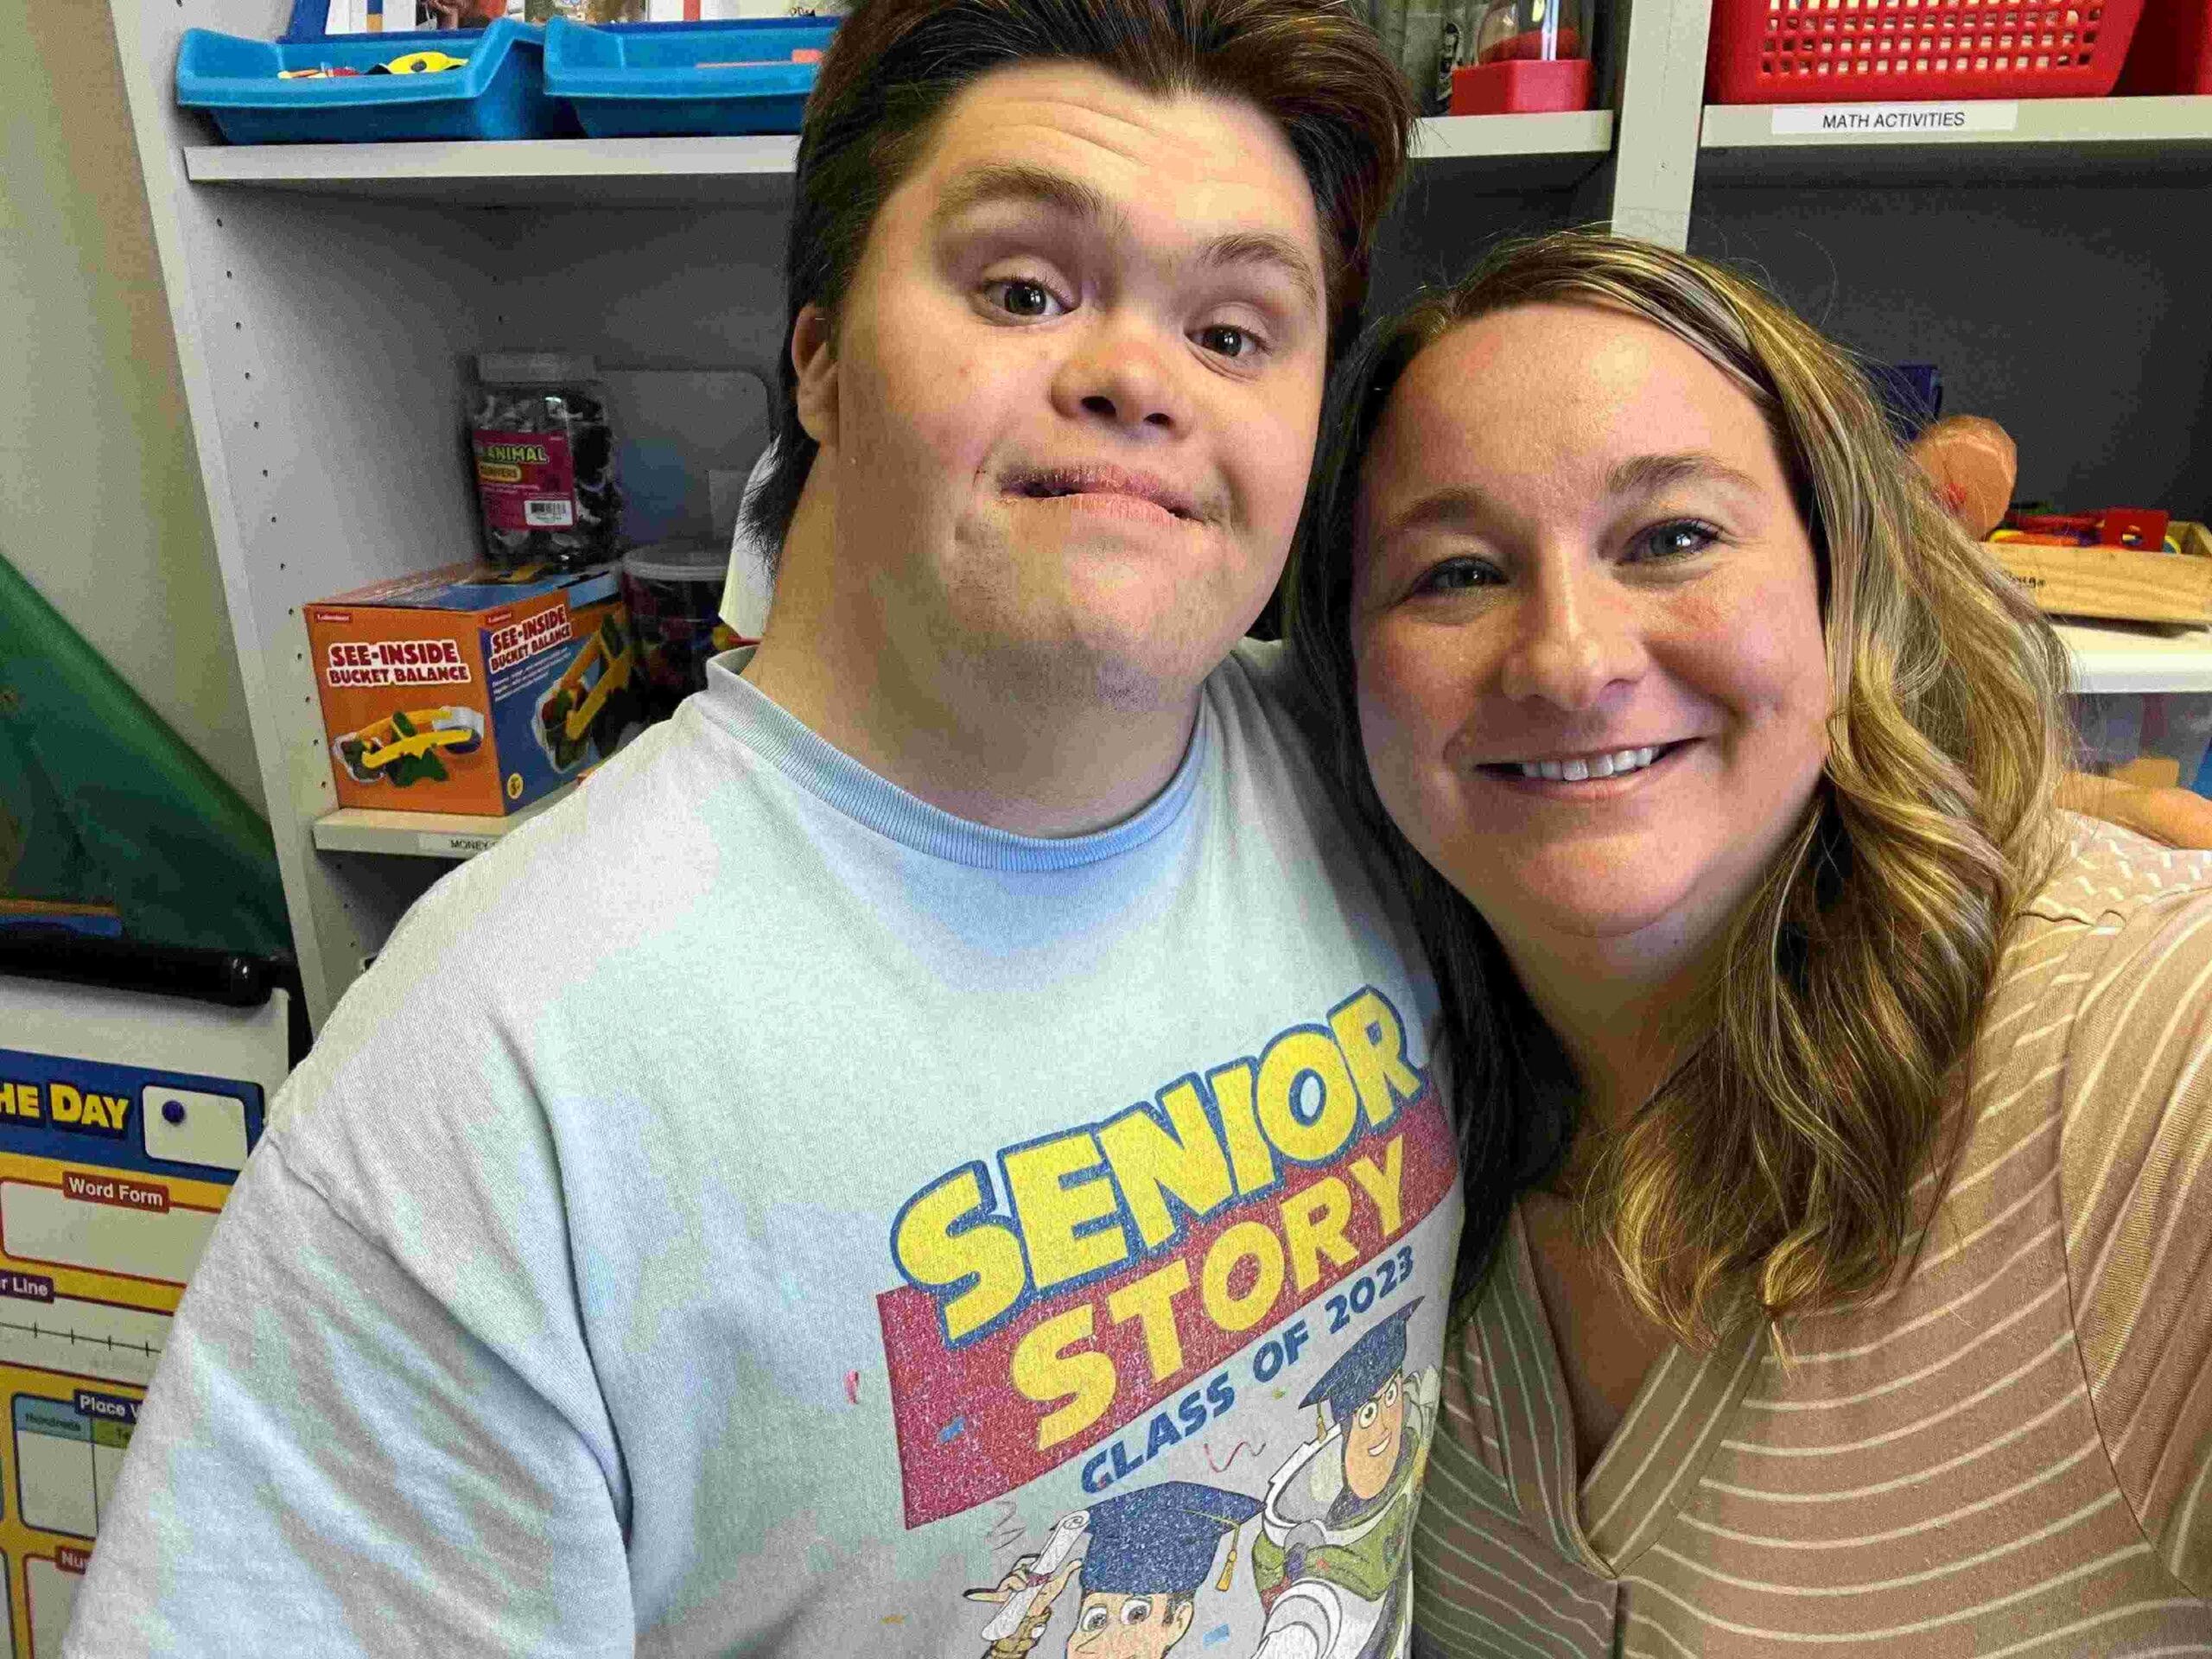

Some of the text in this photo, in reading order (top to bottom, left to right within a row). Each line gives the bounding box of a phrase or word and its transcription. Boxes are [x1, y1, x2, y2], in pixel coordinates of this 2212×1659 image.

[1822, 111, 1966, 129] MATH ACTIVITIES
[486, 445, 548, 463] ANIMAL
[492, 605, 566, 655] SEE-INSIDE
[531, 623, 571, 653] BALANCE
[330, 642, 459, 667] SEE-INSIDE
[328, 665, 469, 684] BUCKET BALANCE
[450, 839, 489, 850] MONEY
[892, 987, 1422, 1346] SENIOR
[69, 1176, 164, 1207] Word Form
[13, 1276, 49, 1296] Line
[1011, 1135, 1406, 1452] STORY
[1081, 1244, 1414, 1494] CLASS OF 2023
[79, 1394, 126, 1417] Place
